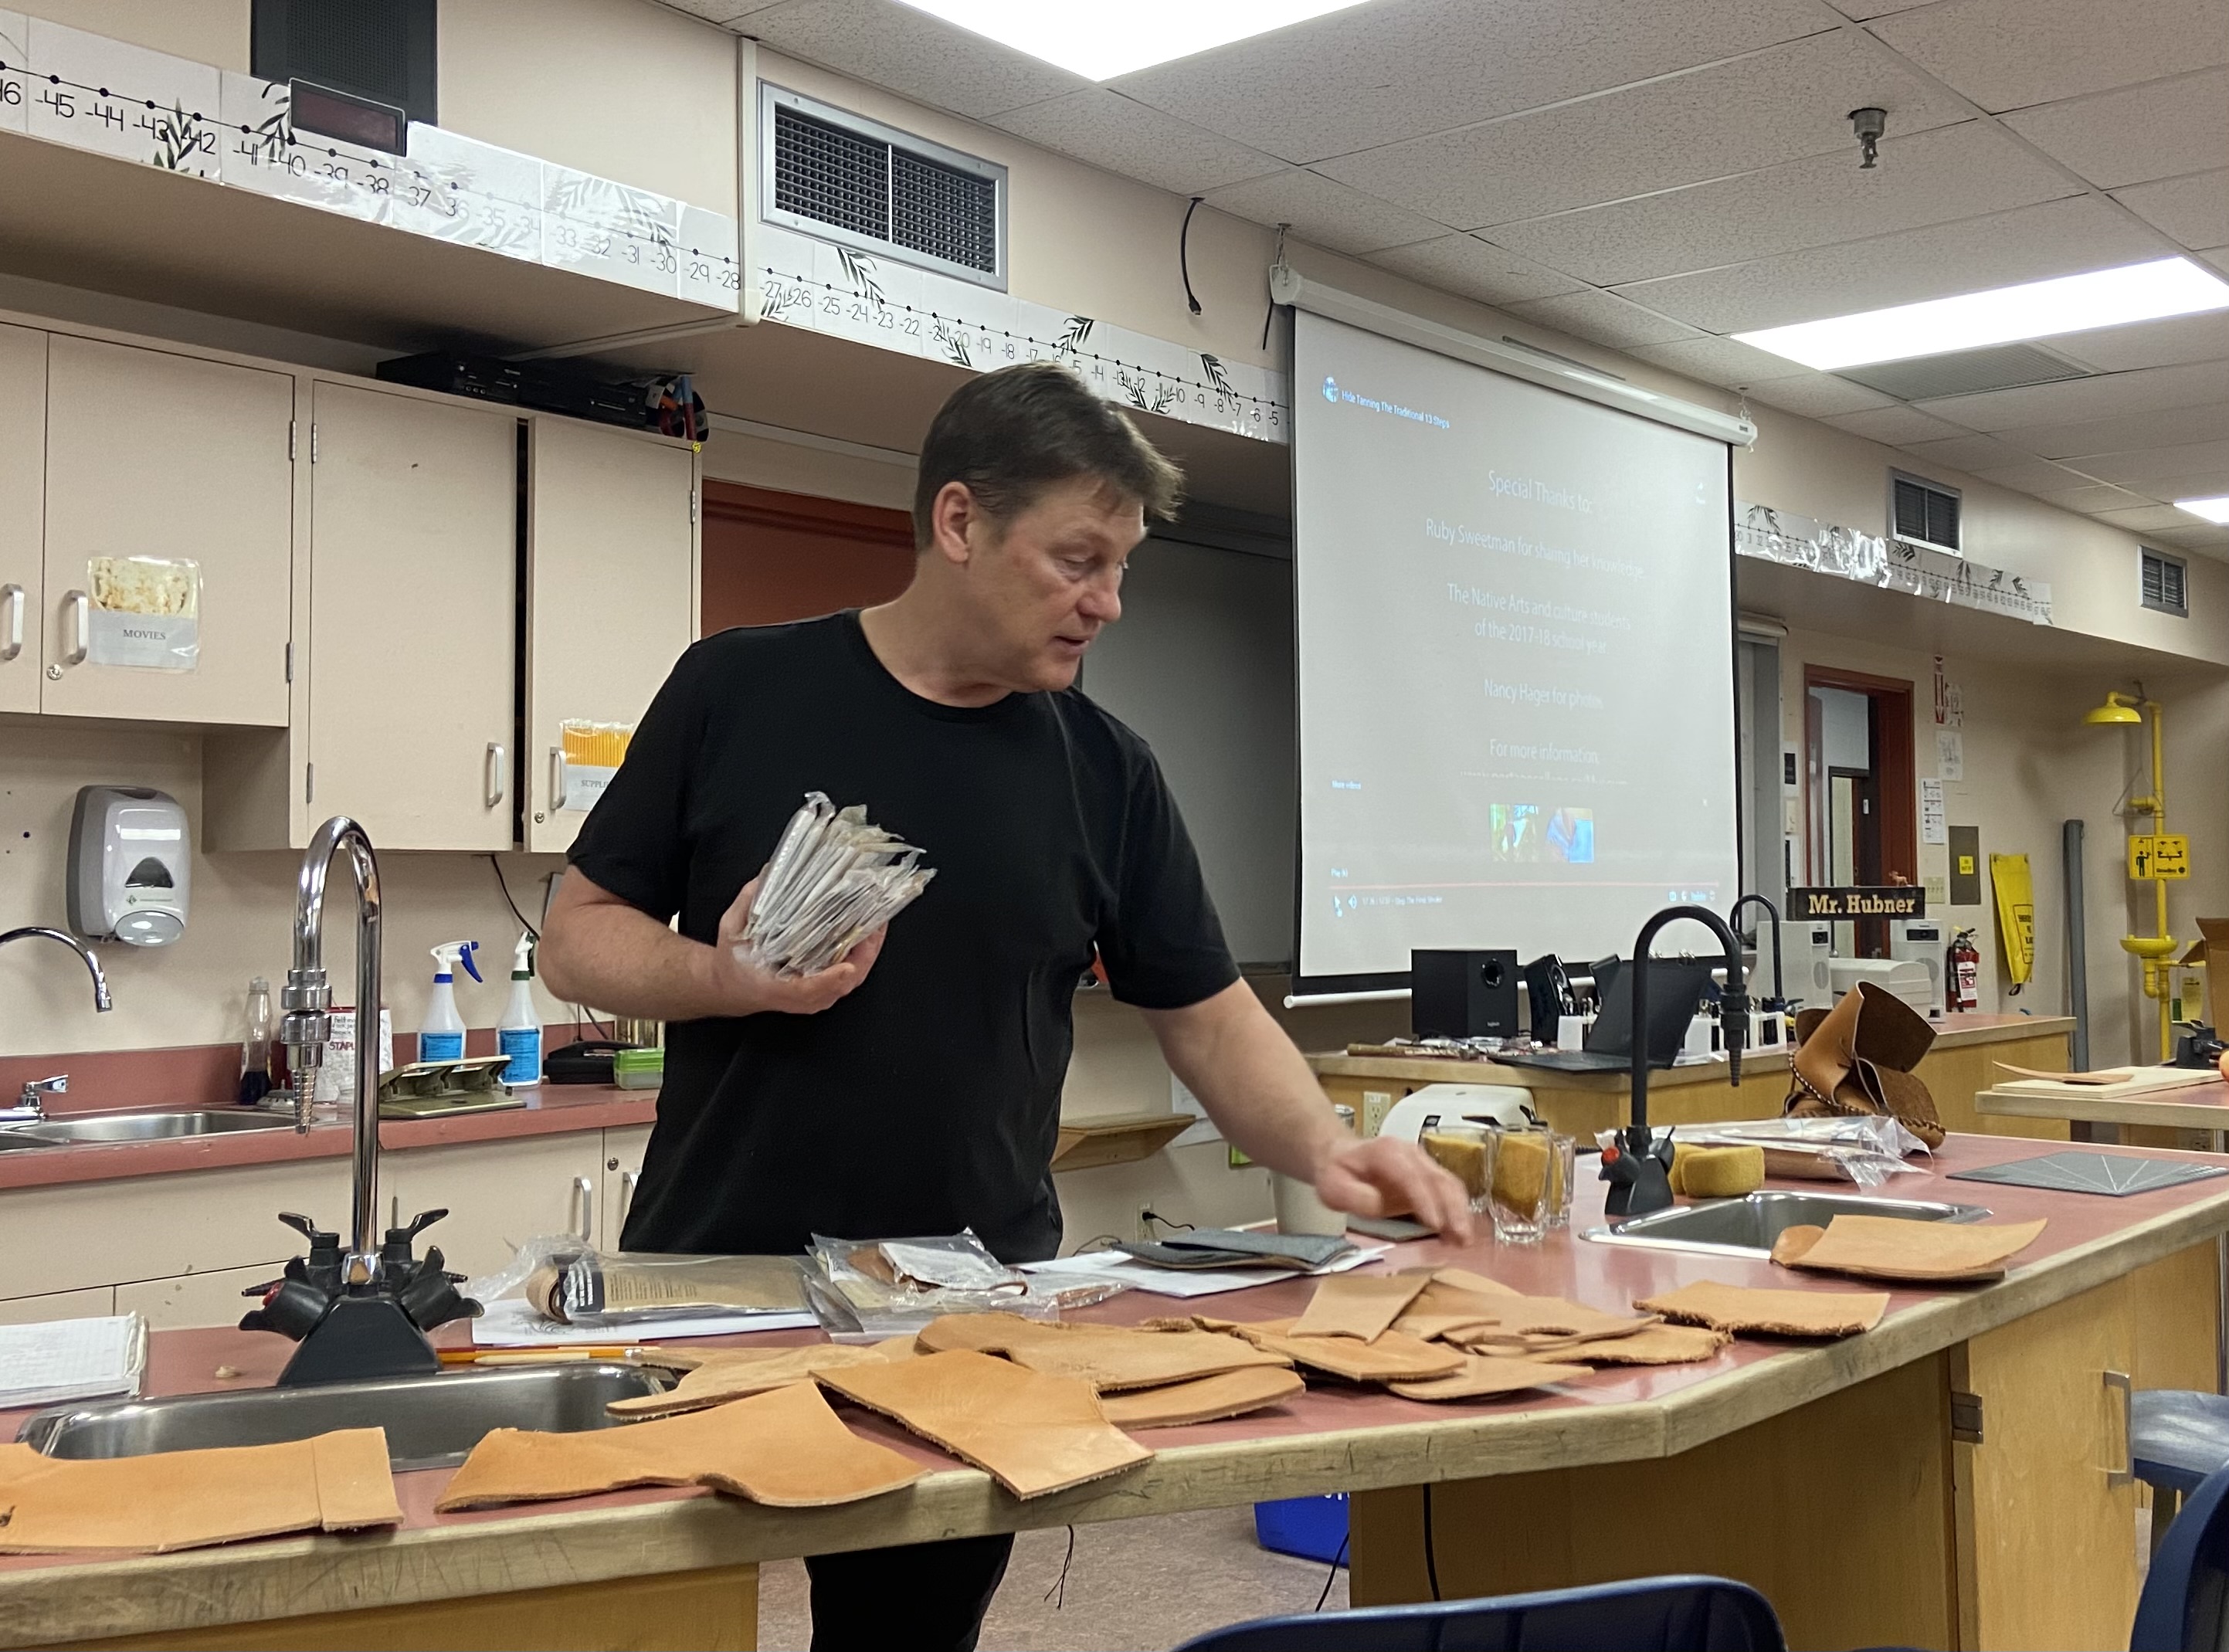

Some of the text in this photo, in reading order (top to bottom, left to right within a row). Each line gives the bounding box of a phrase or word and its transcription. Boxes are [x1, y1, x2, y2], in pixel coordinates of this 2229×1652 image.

[35, 90, 75, 117] -45
[85, 103, 124, 131] -44
[133, 114, 168, 142] -43
[181, 127, 215, 154] -42
[233, 141, 258, 165] -41
[270, 153, 306, 177] -40
[314, 163, 348, 188] -39
[357, 175, 389, 195] -38
[622, 245, 640, 265] -31
[650, 253, 677, 273] -30
[684, 262, 710, 283] -29
[716, 270, 741, 290] -28
[760, 280, 781, 298] -27
[818, 296, 840, 315] -25
[846, 304, 868, 323] -24
[874, 310, 894, 328] -23
[900, 317, 920, 336] -22
[976, 338, 992, 354] -19
[1002, 342, 1015, 360] -18
[1091, 365, 1104, 382] -14
[1134, 376, 1146, 393] -12
[1194, 394, 1205, 409] -9
[1214, 399, 1224, 413] -8
[1232, 402, 1242, 416] -7
[1250, 407, 1261, 422] -6
[1268, 411, 1279, 426] -5
[1342, 389, 1356, 404] Hide
[1356, 394, 1380, 412] Tanning
[1381, 401, 1393, 414] The
[1393, 404, 1424, 422] Traditional
[1425, 412, 1433, 424] 13
[1488, 469, 1532, 497] Special
[1535, 480, 1576, 511] Thanks
[1426, 517, 1456, 546] Ruby
[1457, 524, 1515, 554] Sweetman
[1517, 536, 1533, 557] for
[1535, 541, 1571, 570] sharing
[1573, 548, 1591, 568] her
[1447, 582, 1470, 604] The
[1471, 587, 1506, 611] Native
[1508, 594, 1530, 616] Arts
[1531, 601, 1552, 619] and
[123, 629, 167, 640] MOVIES
[1474, 617, 1488, 637] of
[1488, 619, 1507, 640] the
[1508, 622, 1551, 646] 2017-18
[1484, 679, 1518, 704] Nancy
[1518, 683, 1550, 707] Hager
[1552, 686, 1568, 705] for
[1489, 738, 1509, 758] For
[1509, 744, 1538, 761] more
[1808, 894, 1915, 914] Mr. Hubner
